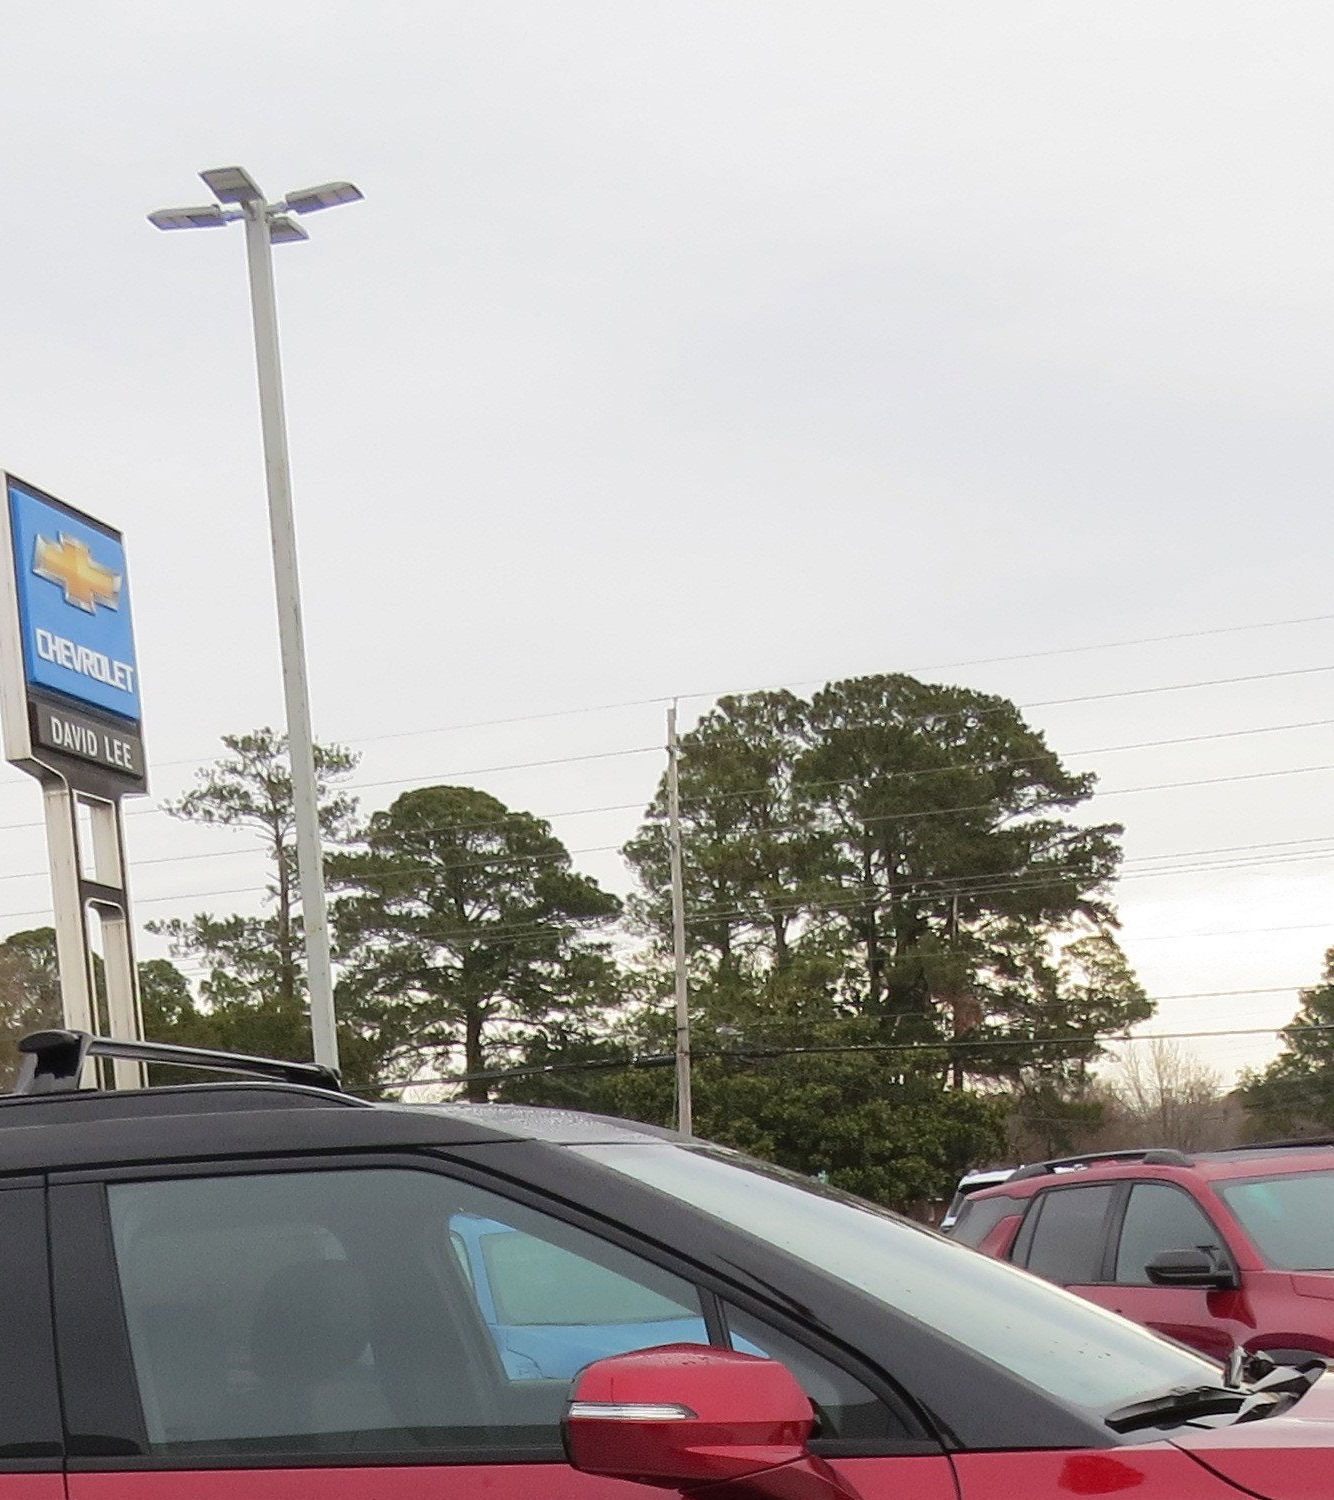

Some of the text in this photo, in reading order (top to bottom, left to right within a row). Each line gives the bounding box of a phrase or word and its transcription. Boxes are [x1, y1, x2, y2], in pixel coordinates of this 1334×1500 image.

[35, 627, 134, 693] CHEVROLET
[50, 716, 133, 769] DAVID LEE
